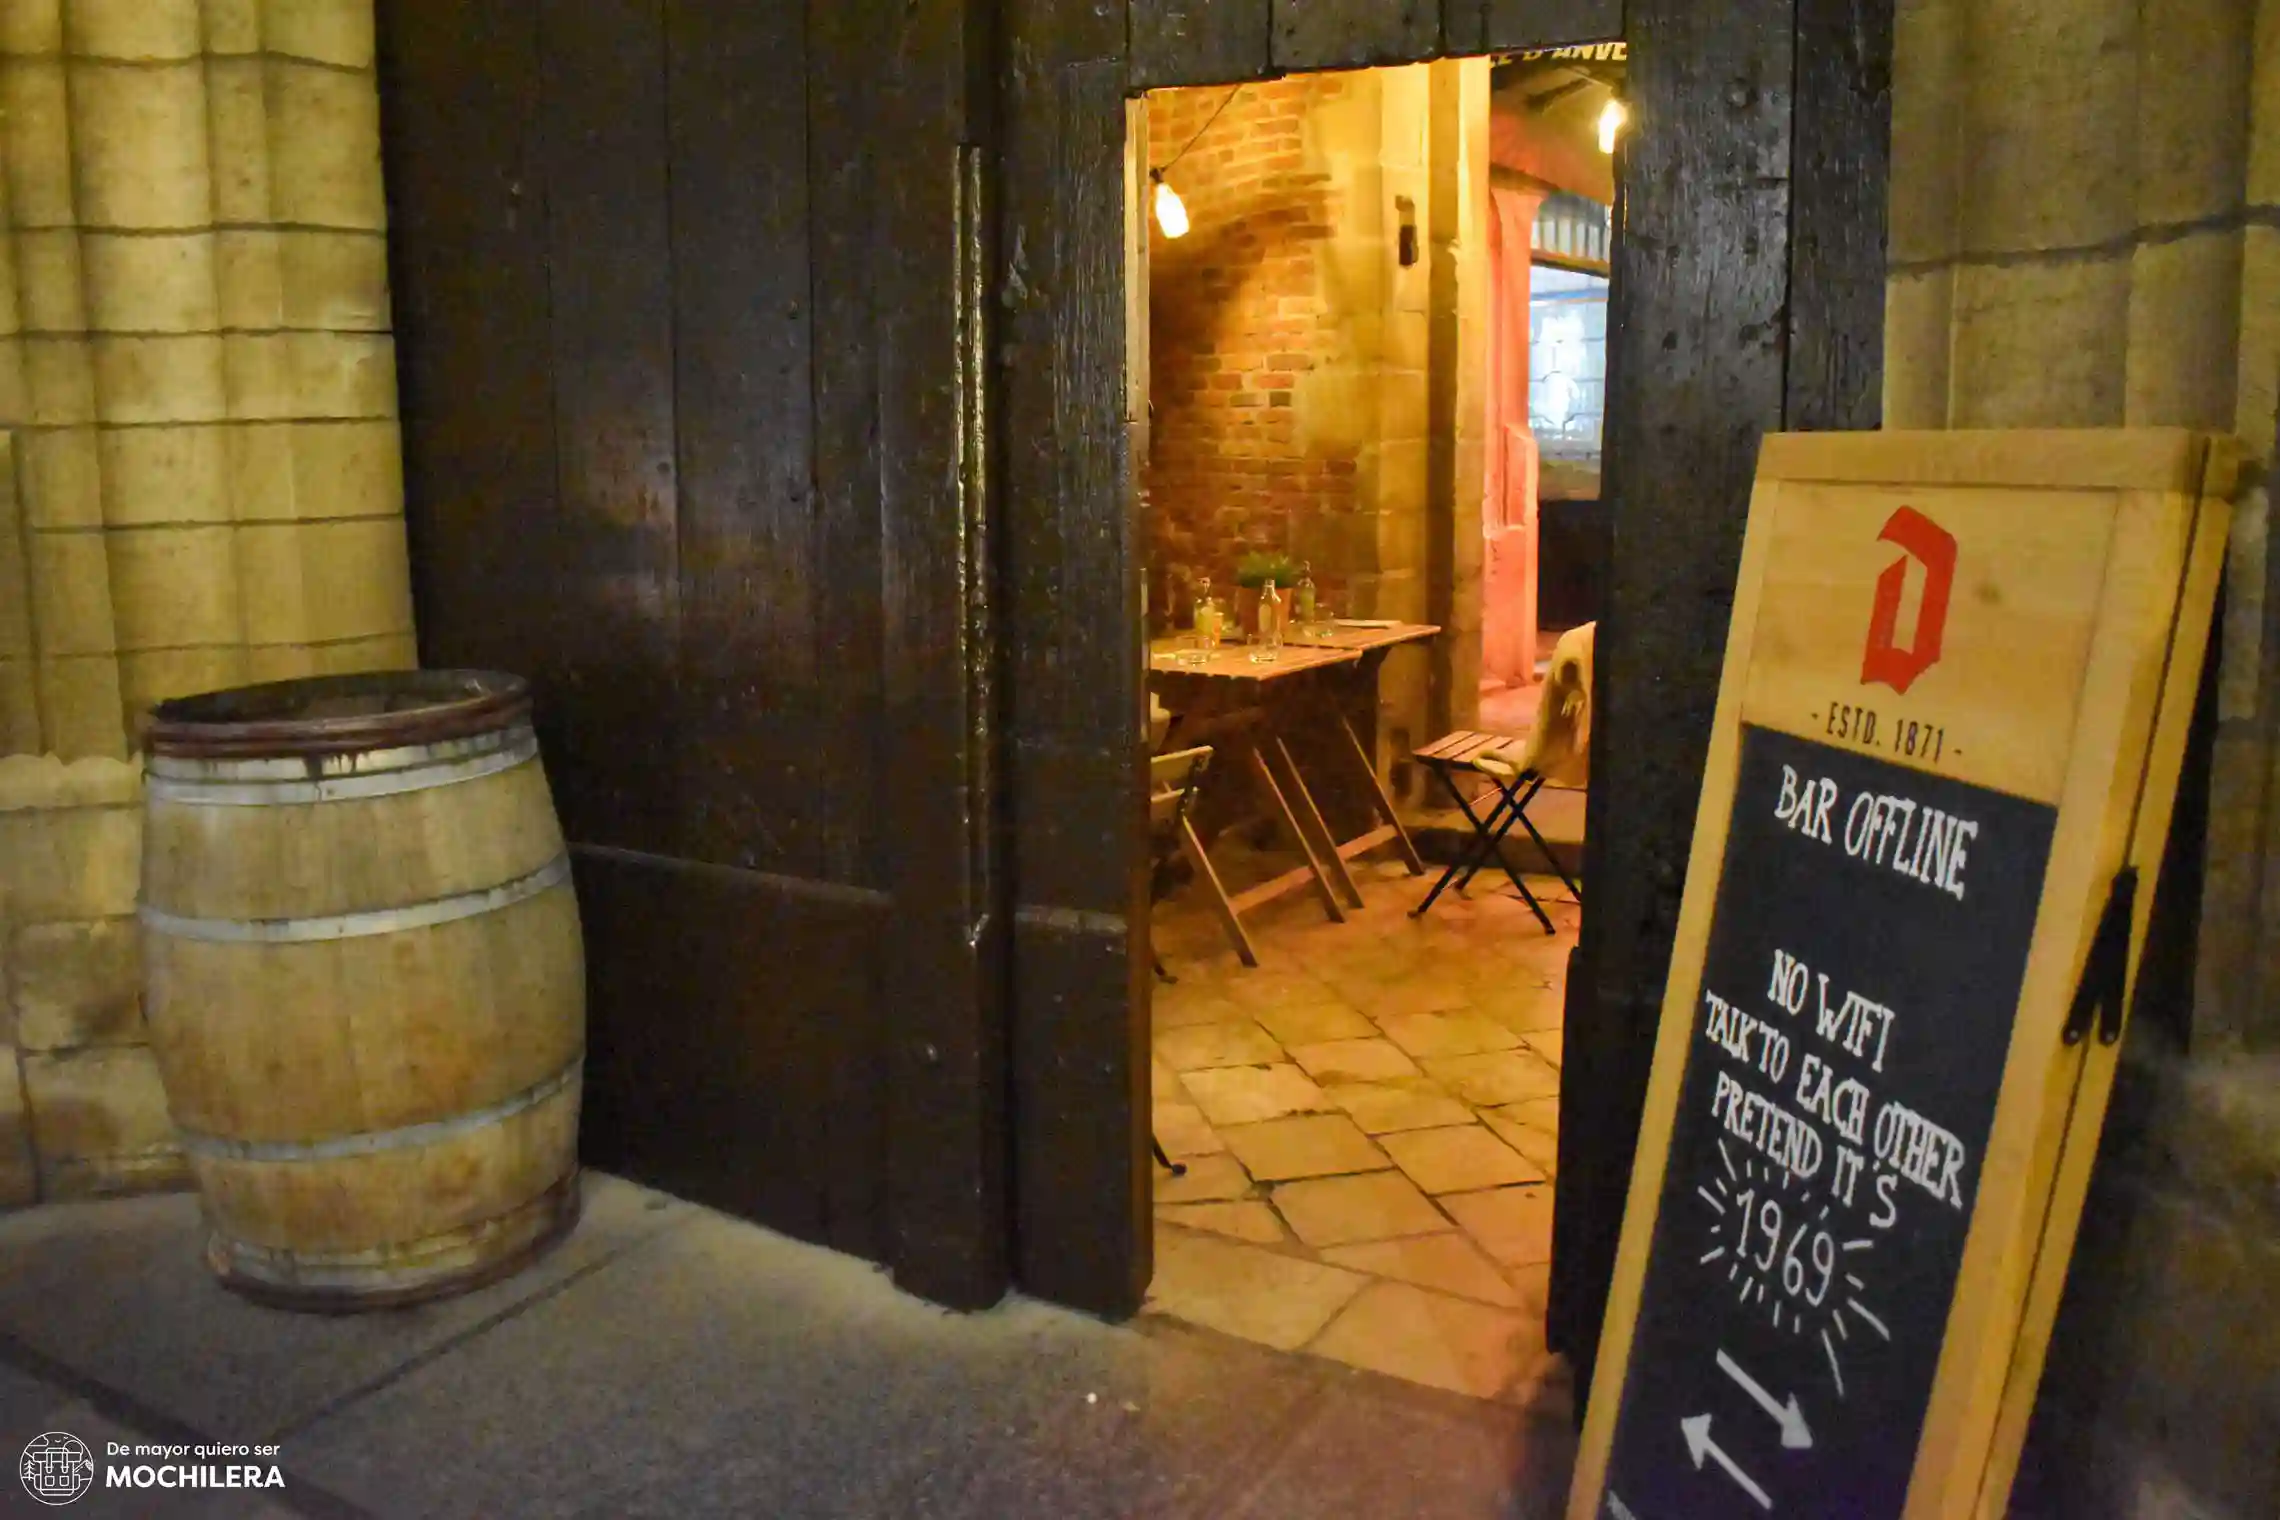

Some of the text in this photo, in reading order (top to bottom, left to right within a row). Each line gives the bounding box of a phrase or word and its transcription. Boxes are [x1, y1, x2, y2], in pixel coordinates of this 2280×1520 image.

[1860, 505, 1958, 696] D
[1826, 702, 1944, 764] ESTD. 1871
[1774, 764, 1978, 901] BAR OFFLINE
[1768, 949, 1896, 1073] NO WIFI
[1705, 989, 1965, 1209] TALK TO EACH OTHER
[1711, 1071, 1898, 1229] PRETEND IT'S
[1736, 1188, 1834, 1307] 1969
